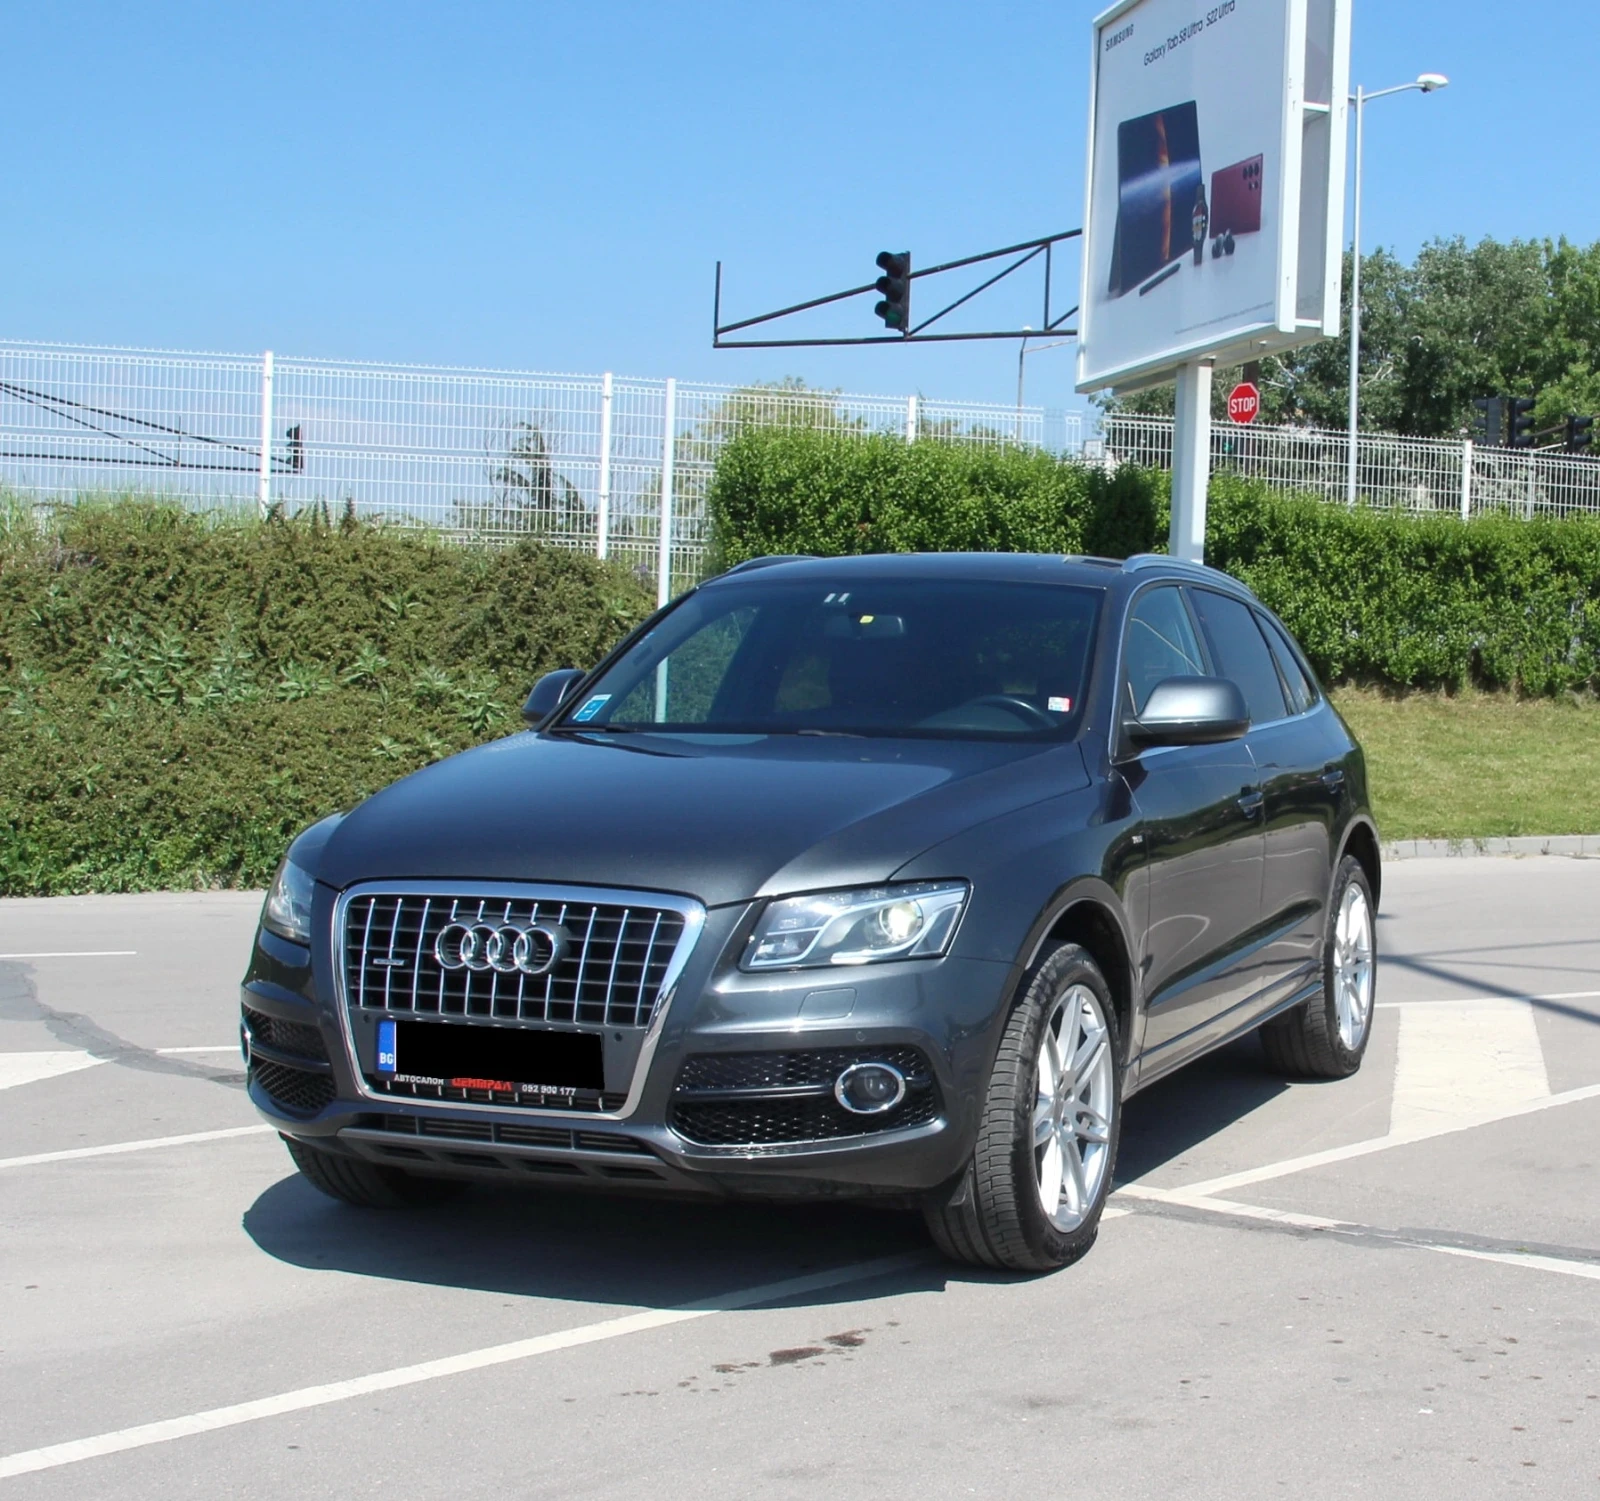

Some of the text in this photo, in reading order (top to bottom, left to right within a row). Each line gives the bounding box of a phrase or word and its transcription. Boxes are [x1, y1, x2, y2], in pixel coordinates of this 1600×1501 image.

[1106, 23, 1134, 52] SAMSUNG
[1143, 44, 1166, 66] Galaxy
[1166, 34, 1179, 51] Tab
[1187, 19, 1203, 39] Ultra
[1206, 7, 1218, 27] S22
[1218, 0, 1235, 19] Ultra
[1230, 396, 1256, 414] STOP
[379, 1052, 394, 1065] BG
[394, 1074, 444, 1086] АВТОСАЛОН
[559, 1086, 577, 1096] 177
